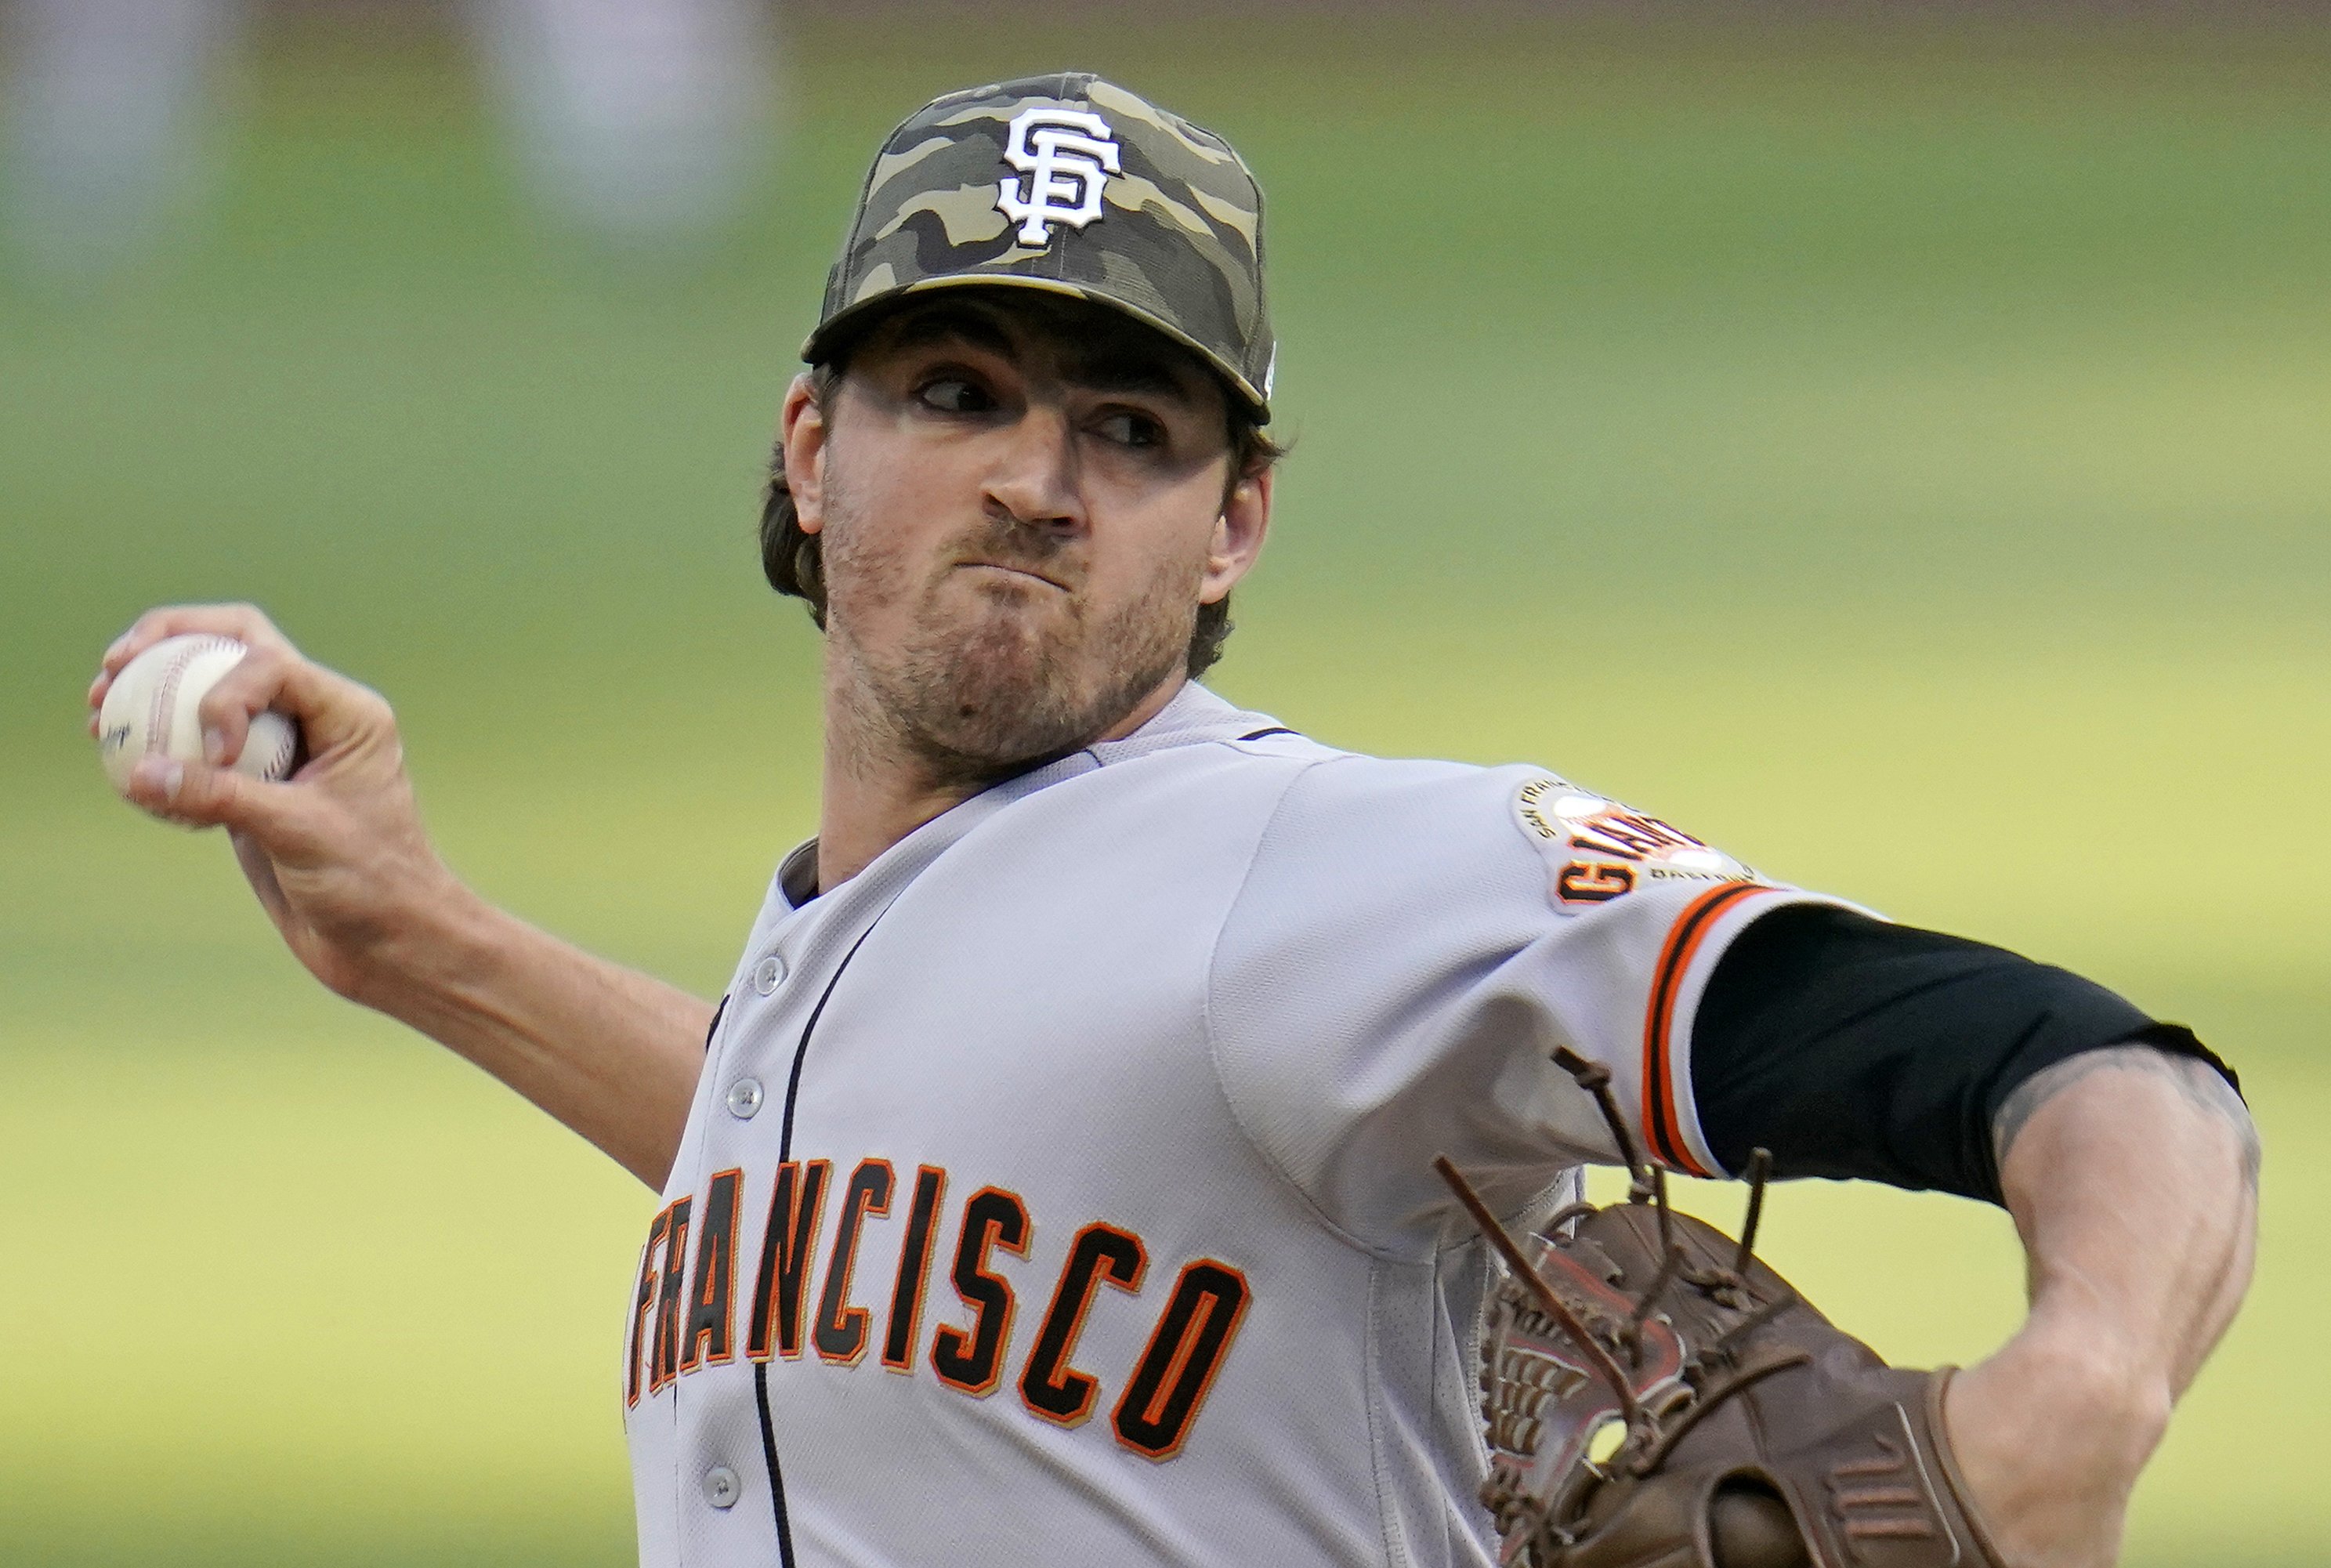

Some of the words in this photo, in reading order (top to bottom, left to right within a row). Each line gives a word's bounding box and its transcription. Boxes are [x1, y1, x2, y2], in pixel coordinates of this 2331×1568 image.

[995, 107, 1124, 248] SF
[1518, 809, 1556, 839] SAN
[628, 1157, 1253, 1463] FRANCISCO
